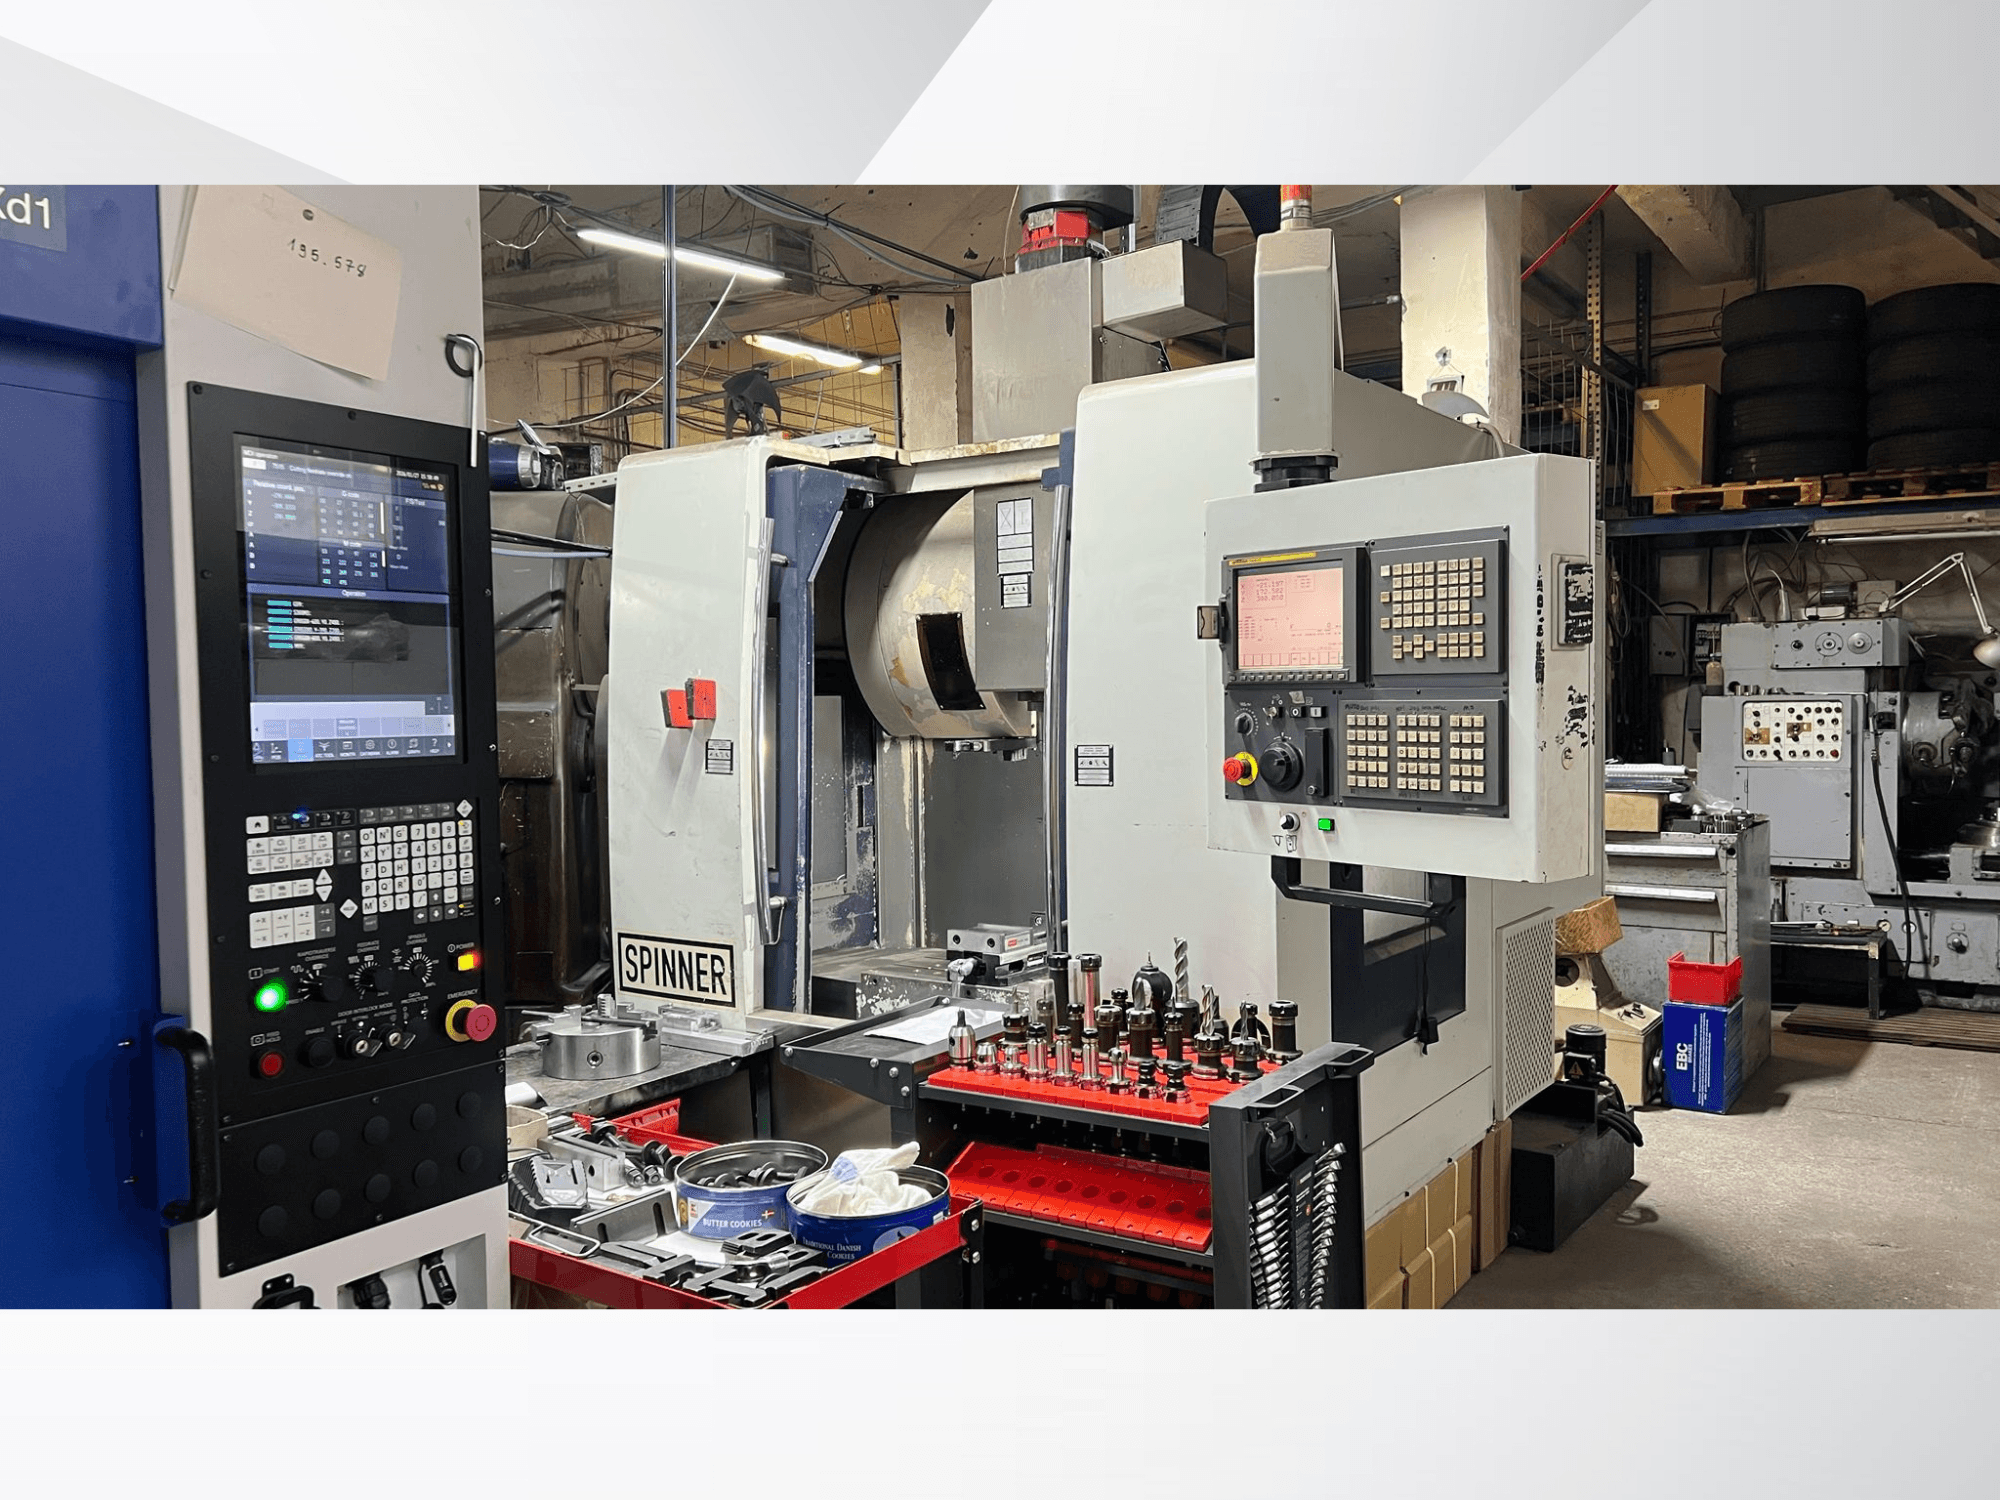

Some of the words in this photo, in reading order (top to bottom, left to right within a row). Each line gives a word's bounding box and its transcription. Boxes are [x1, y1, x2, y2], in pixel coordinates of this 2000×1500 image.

[0, 187, 50, 229] d1
[625, 943, 727, 995] SPINNER
[447, 988, 478, 999] EMERGENCY
[1676, 1042, 1688, 1071] EBC
[702, 1217, 729, 1229] BUTTER
[730, 1219, 763, 1229] COOKIES
[836, 1242, 862, 1252] DANISH
[826, 1250, 856, 1260] COOKIES
